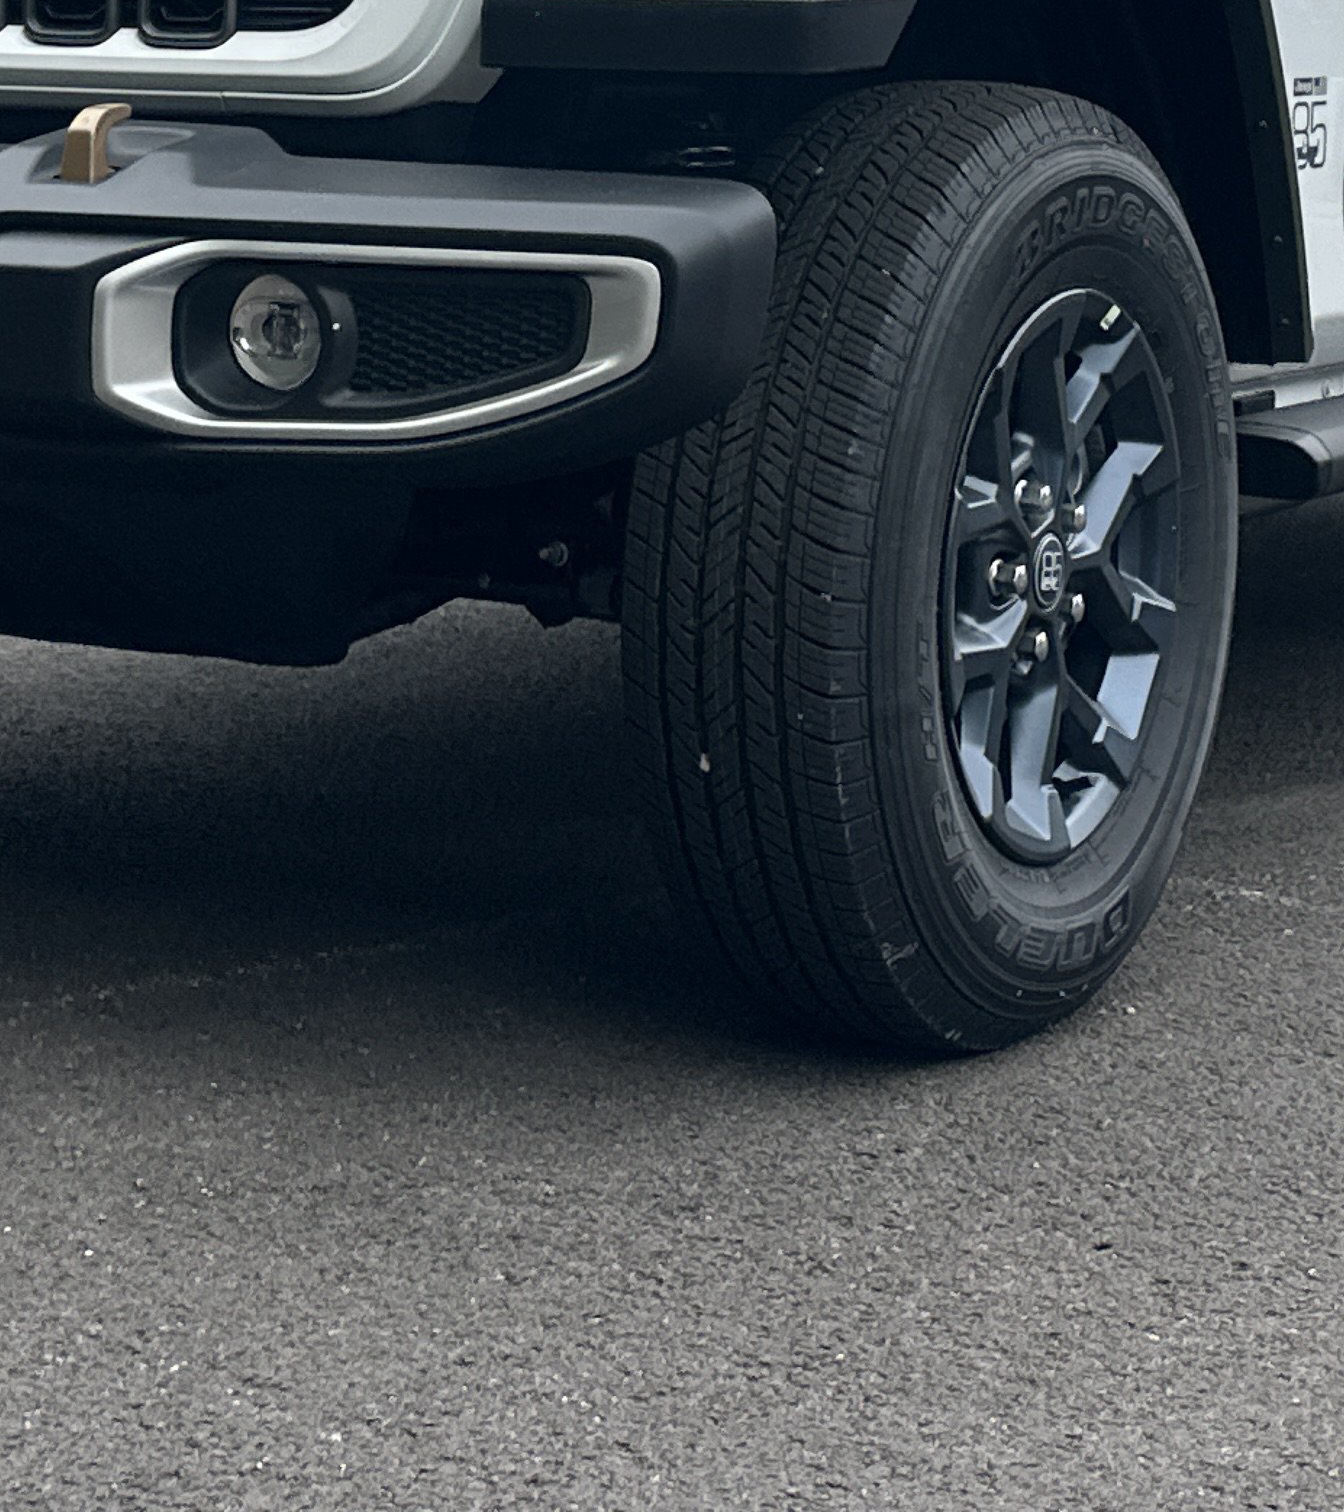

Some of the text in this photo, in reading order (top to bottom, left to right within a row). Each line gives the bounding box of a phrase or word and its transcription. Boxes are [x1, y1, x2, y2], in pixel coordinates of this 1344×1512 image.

[1013, 185, 1232, 462] BRIDGESTONE
[918, 622, 939, 763] H/T
[932, 791, 1131, 972] DUELER
